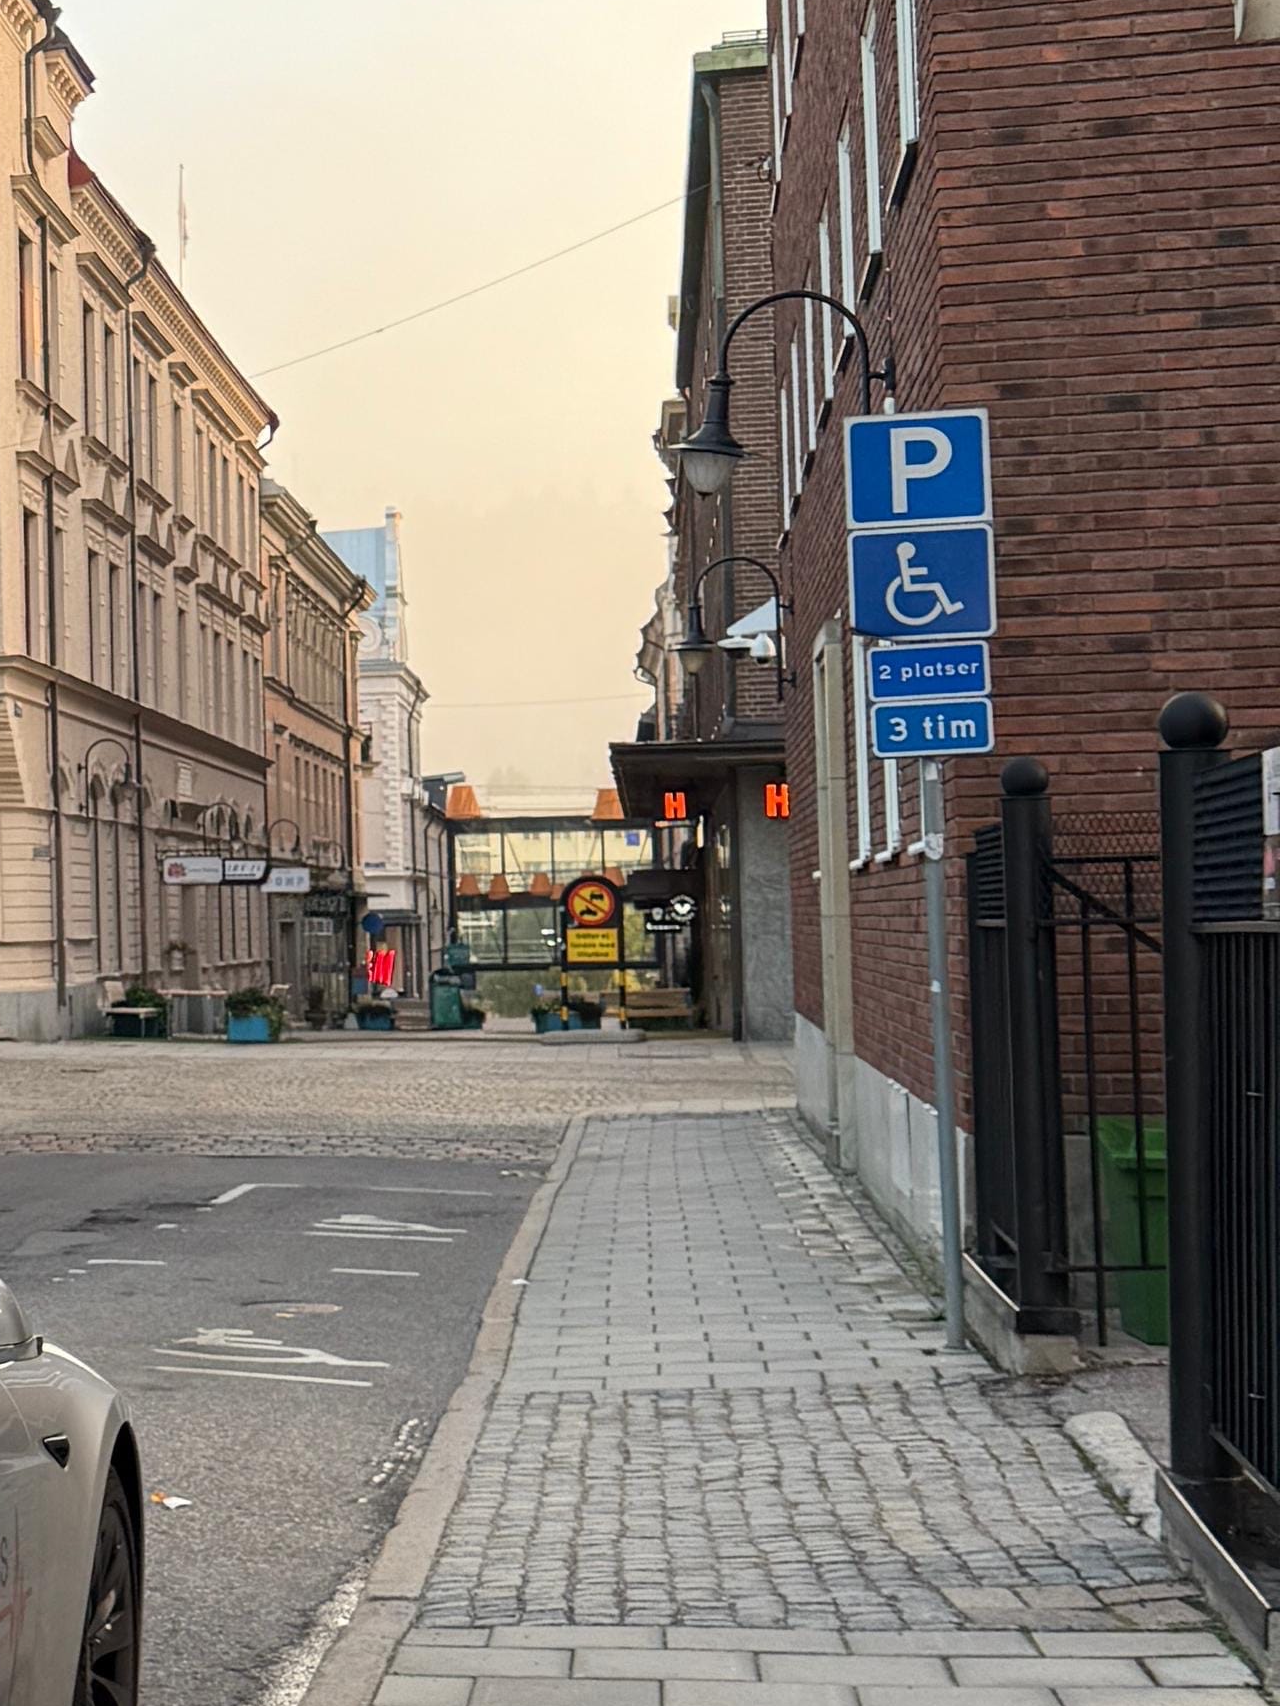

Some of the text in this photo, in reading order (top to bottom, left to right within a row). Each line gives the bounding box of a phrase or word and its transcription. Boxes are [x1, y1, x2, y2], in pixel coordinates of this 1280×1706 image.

[889, 425, 953, 514] P
[878, 661, 980, 682] 2 platser
[888, 713, 977, 743] 3 tim
[664, 791, 687, 819] H
[765, 783, 790, 818] H
